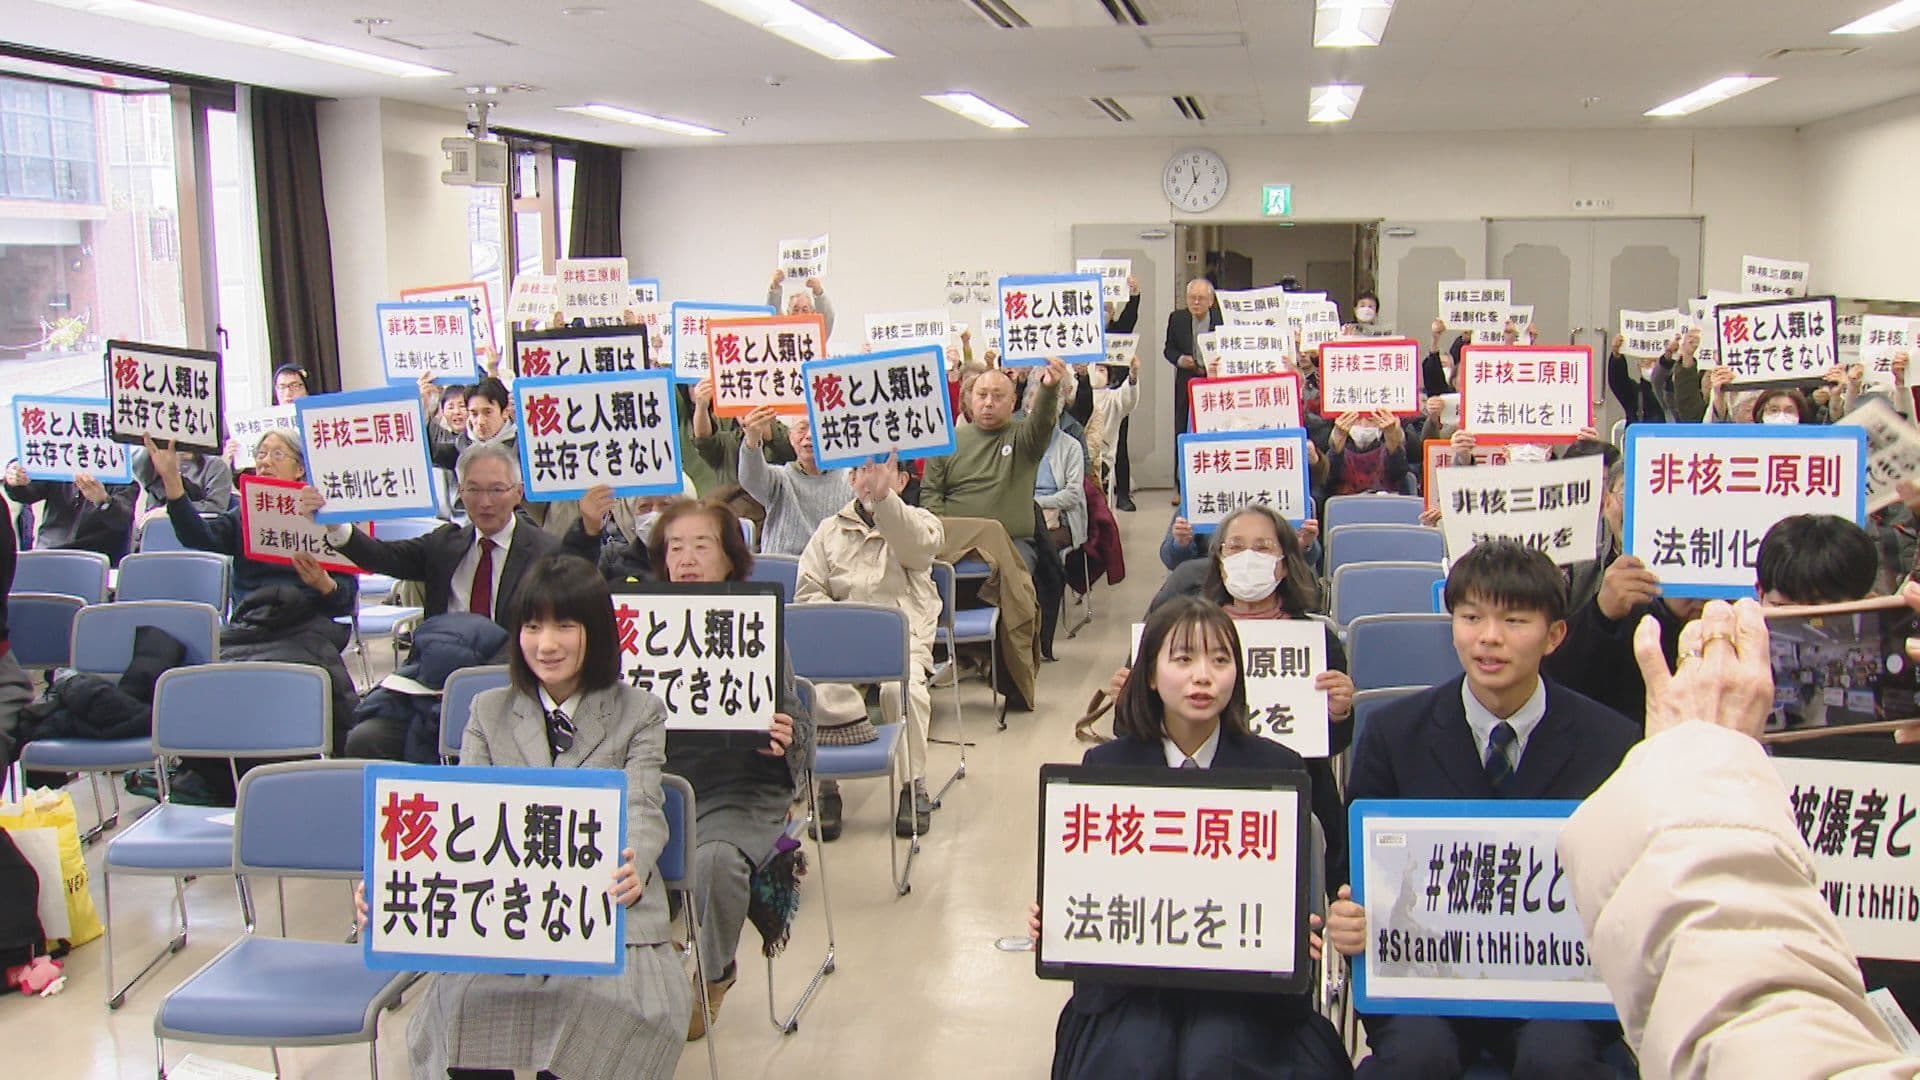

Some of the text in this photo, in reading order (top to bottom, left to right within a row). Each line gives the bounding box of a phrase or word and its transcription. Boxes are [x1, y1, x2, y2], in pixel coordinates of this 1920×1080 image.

[564, 267, 621, 284] 非核三原則
[1004, 289, 1095, 321] 核と人類は
[387, 314, 465, 338] 非核三原則
[871, 321, 944, 341] 非核三原則
[1007, 320, 1101, 352] 共存できない
[1723, 312, 1826, 346] 核と人類は
[1869, 329, 1907, 346] 非核
[394, 350, 464, 371] 法制化を!!
[522, 346, 636, 377] 核と人類は
[714, 333, 815, 365] 核と人類は
[1330, 352, 1410, 373] 非核三原則
[1728, 343, 1833, 376] 共存できない
[113, 355, 210, 399] 核と人類は
[812, 364, 933, 412] 核と人類は
[1474, 360, 1579, 385] 非核三原則
[1201, 385, 1290, 413] 非核三原則
[1331, 385, 1406, 405] 法制化を!!
[117, 394, 216, 435] 共存できない
[525, 391, 662, 437] 核と人類は
[821, 405, 945, 451] 共存できない
[1476, 401, 1573, 426] 法制化を!!
[312, 413, 415, 450] 非核三原則
[26, 440, 125, 469] 共存できない
[534, 437, 673, 482] 共存できない
[1193, 446, 1294, 474] 非核三原則
[323, 468, 416, 501] 法制化を!!
[1648, 453, 1842, 498] 非核三原則
[1452, 479, 1591, 515] 非核三原則
[380, 791, 604, 871] 核と人類は
[1062, 802, 1279, 862] 非核三原則
[383, 869, 612, 943] 共存できない
[1063, 892, 1264, 951] 法制化を!!
